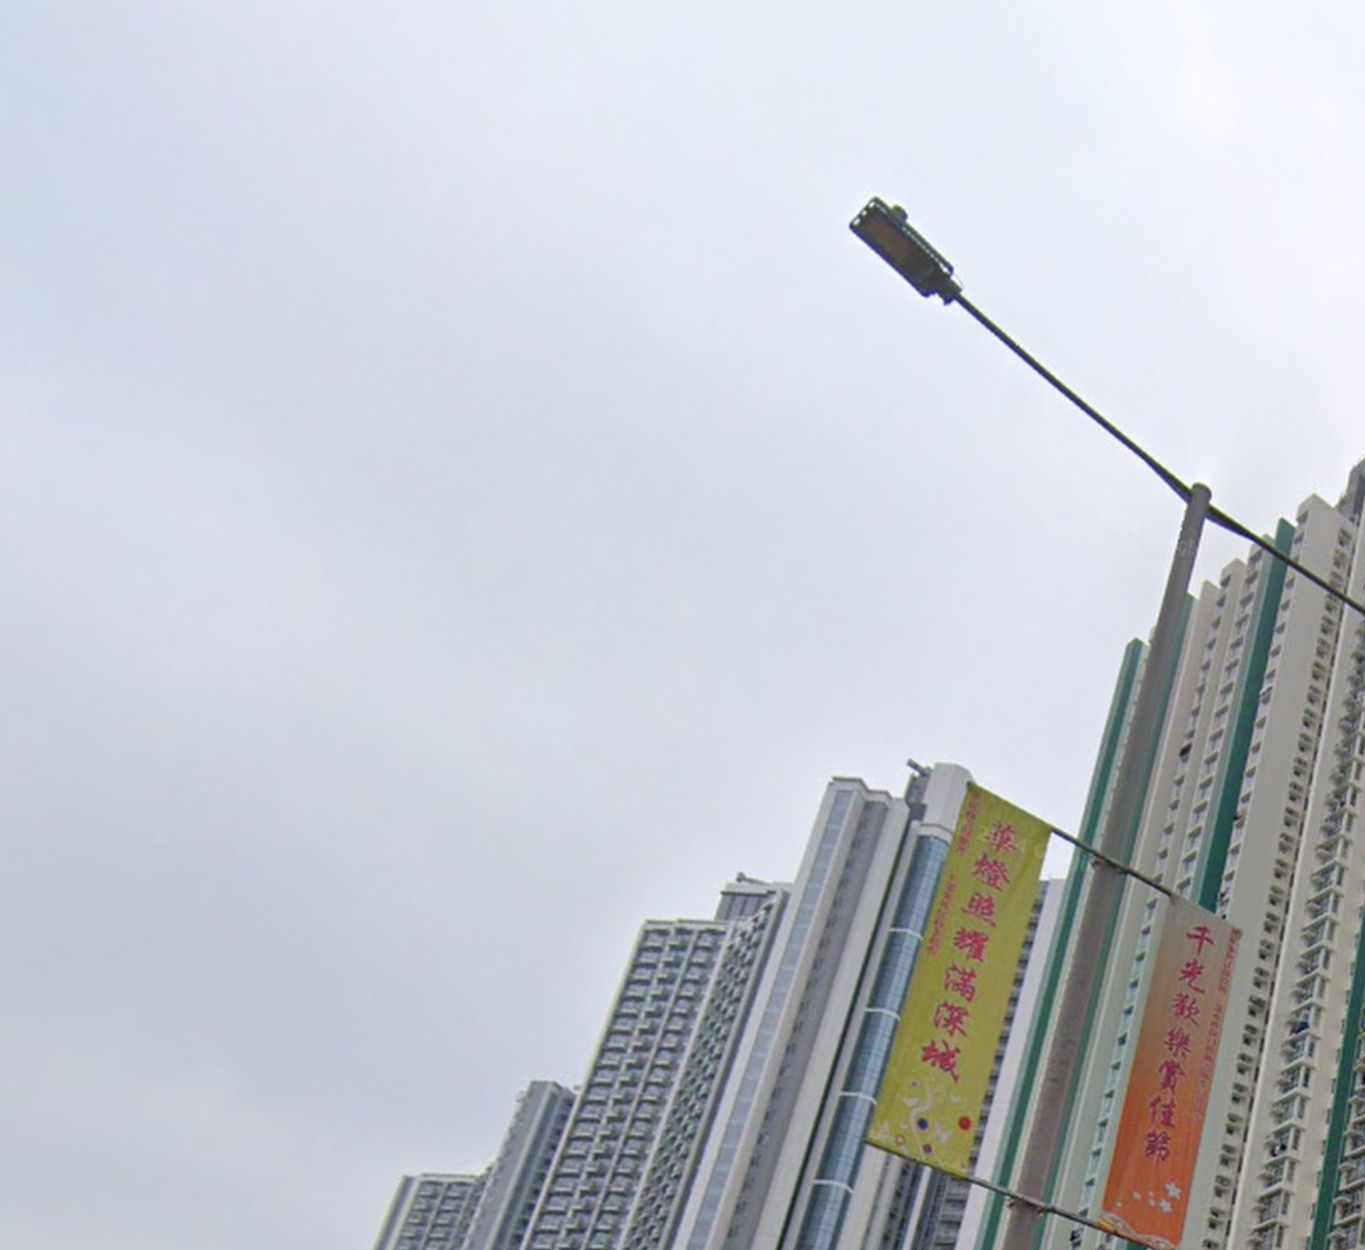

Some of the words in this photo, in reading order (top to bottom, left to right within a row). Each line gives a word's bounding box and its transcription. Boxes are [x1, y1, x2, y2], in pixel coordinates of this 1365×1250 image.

[920, 820, 1019, 1084] 華燈照耀滿深城
[1144, 925, 1215, 1163] 千光歡樂賞佳節
